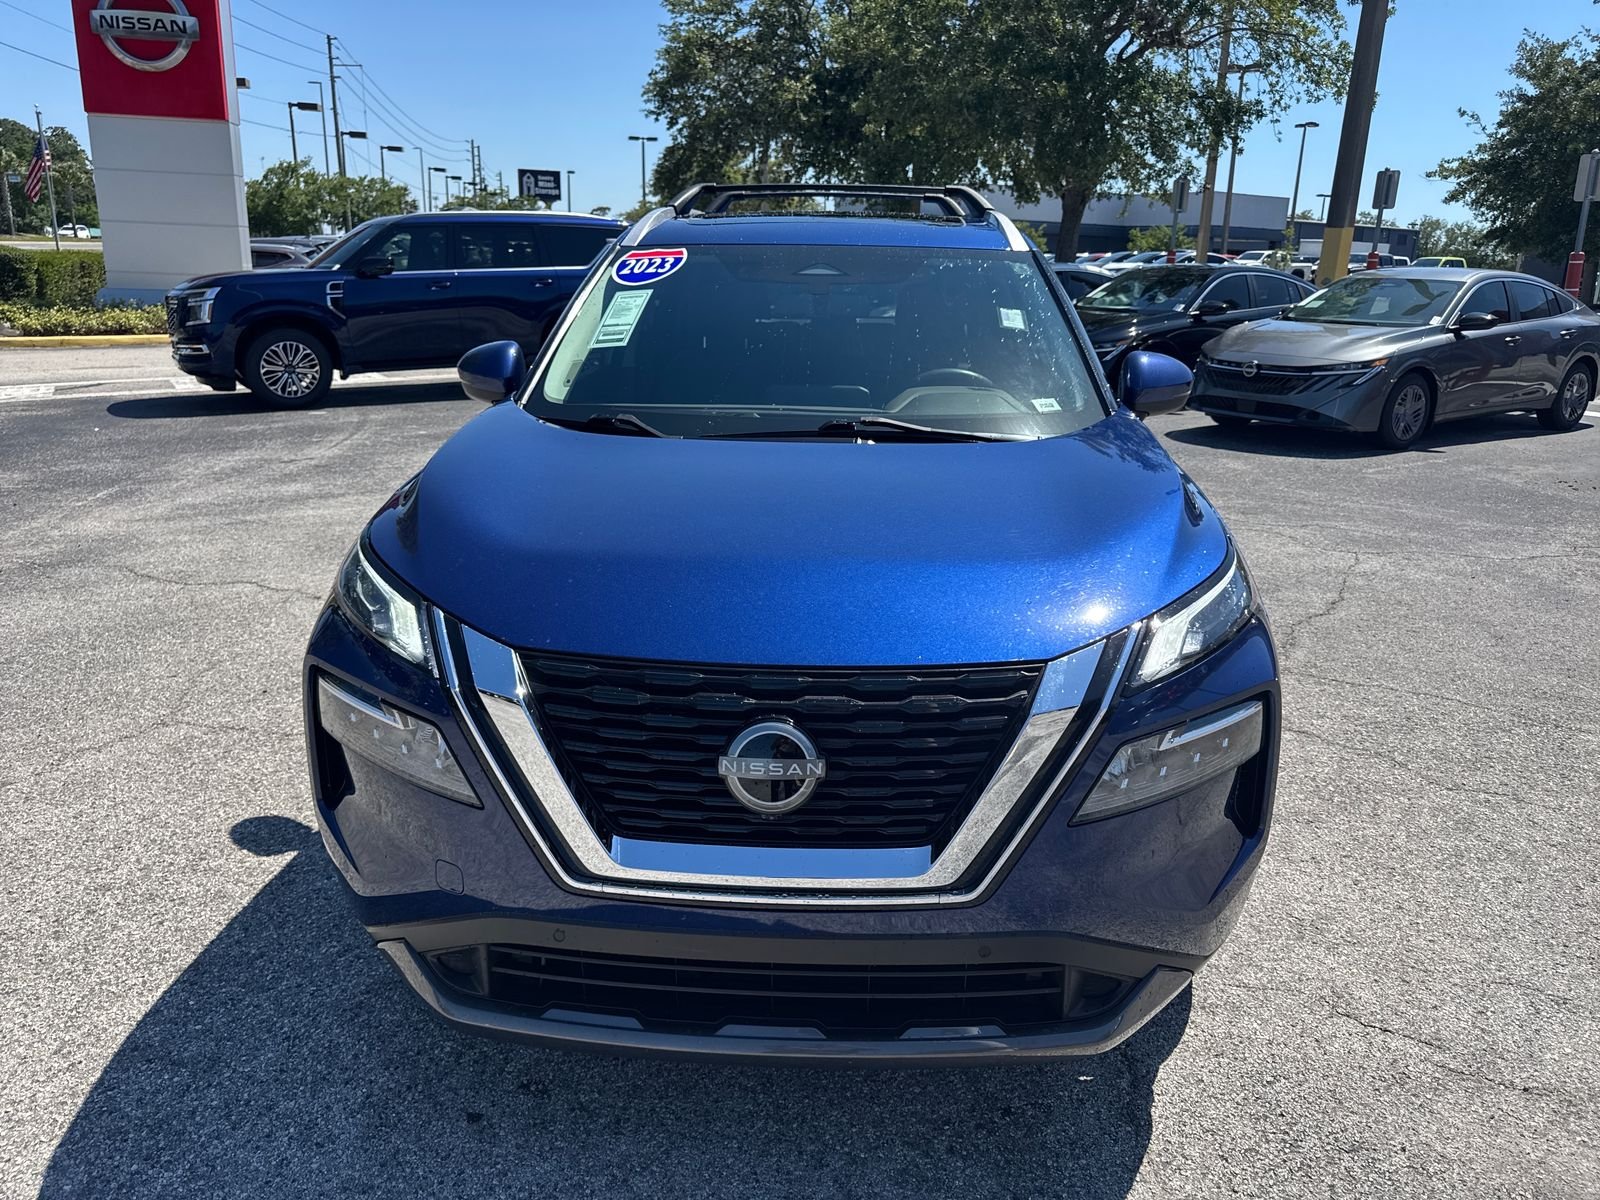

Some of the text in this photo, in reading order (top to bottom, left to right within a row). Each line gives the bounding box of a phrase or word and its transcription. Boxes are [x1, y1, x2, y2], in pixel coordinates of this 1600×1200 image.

[99, 14, 188, 34] NISSAN
[535, 187, 560, 195] Storage
[618, 257, 675, 275] 2023
[721, 759, 823, 776] NISSAN
